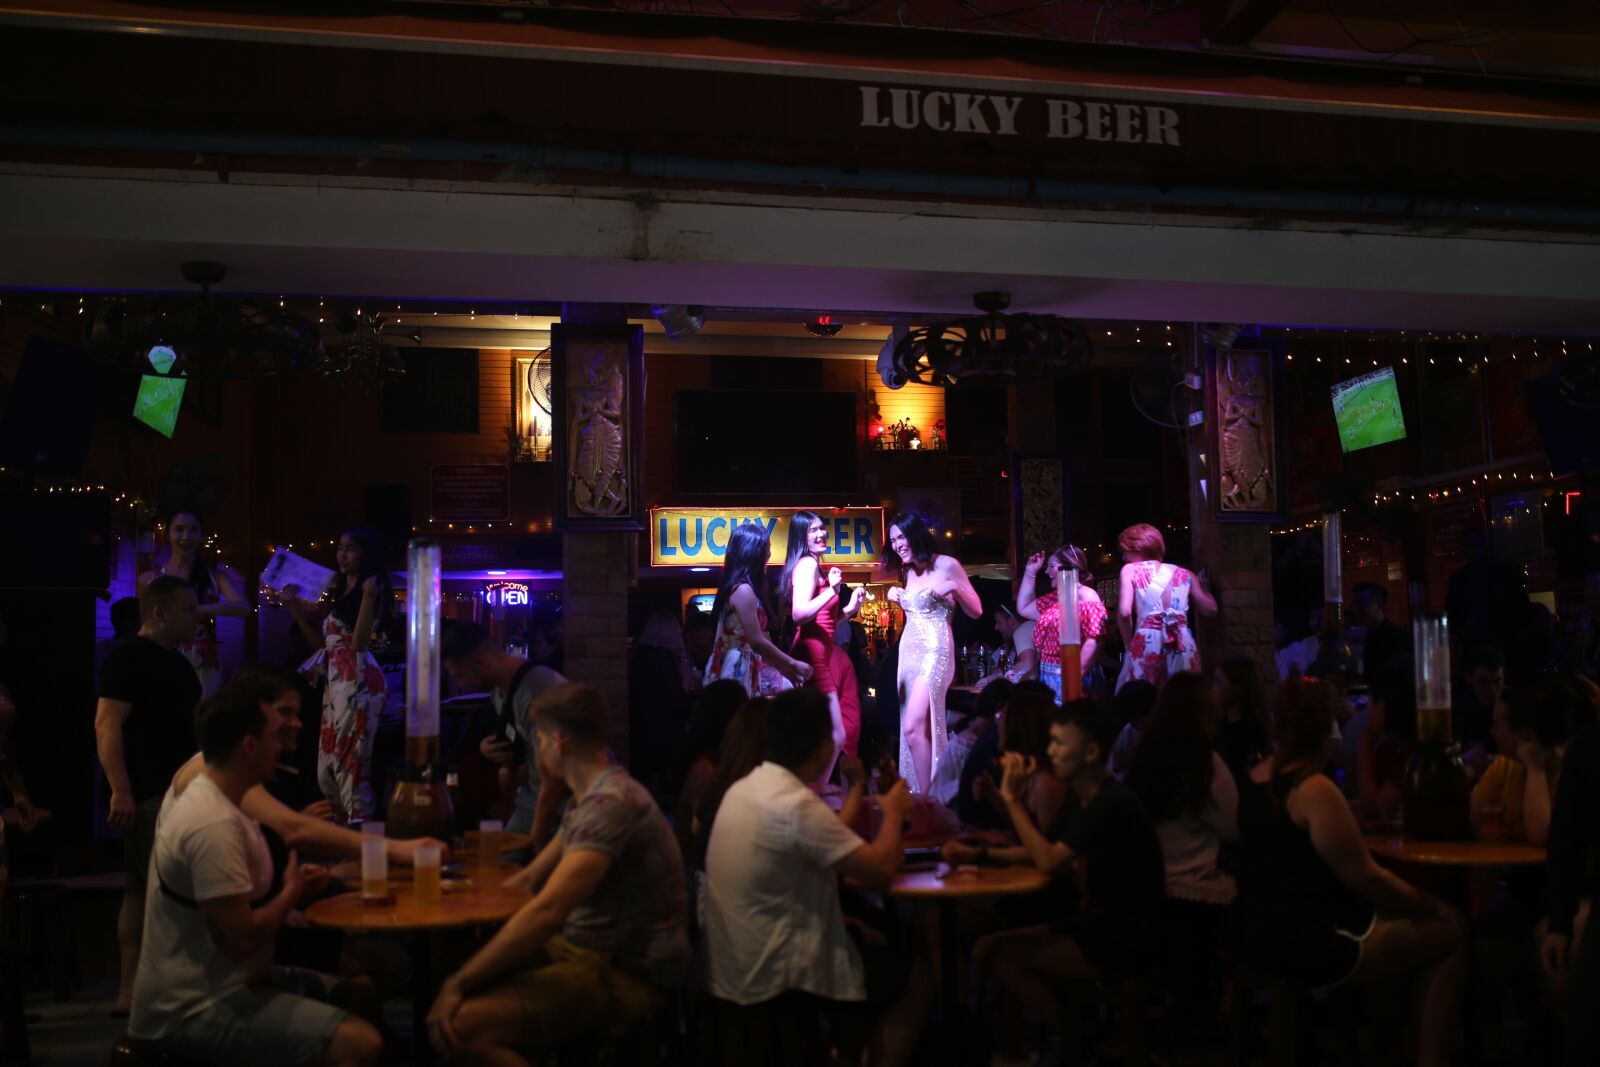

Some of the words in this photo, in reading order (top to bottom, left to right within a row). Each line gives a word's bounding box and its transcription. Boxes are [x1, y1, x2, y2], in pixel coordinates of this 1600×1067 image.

[859, 86, 1023, 136] LUCKY
[1045, 99, 1181, 147] BEER
[817, 517, 875, 555] ER
